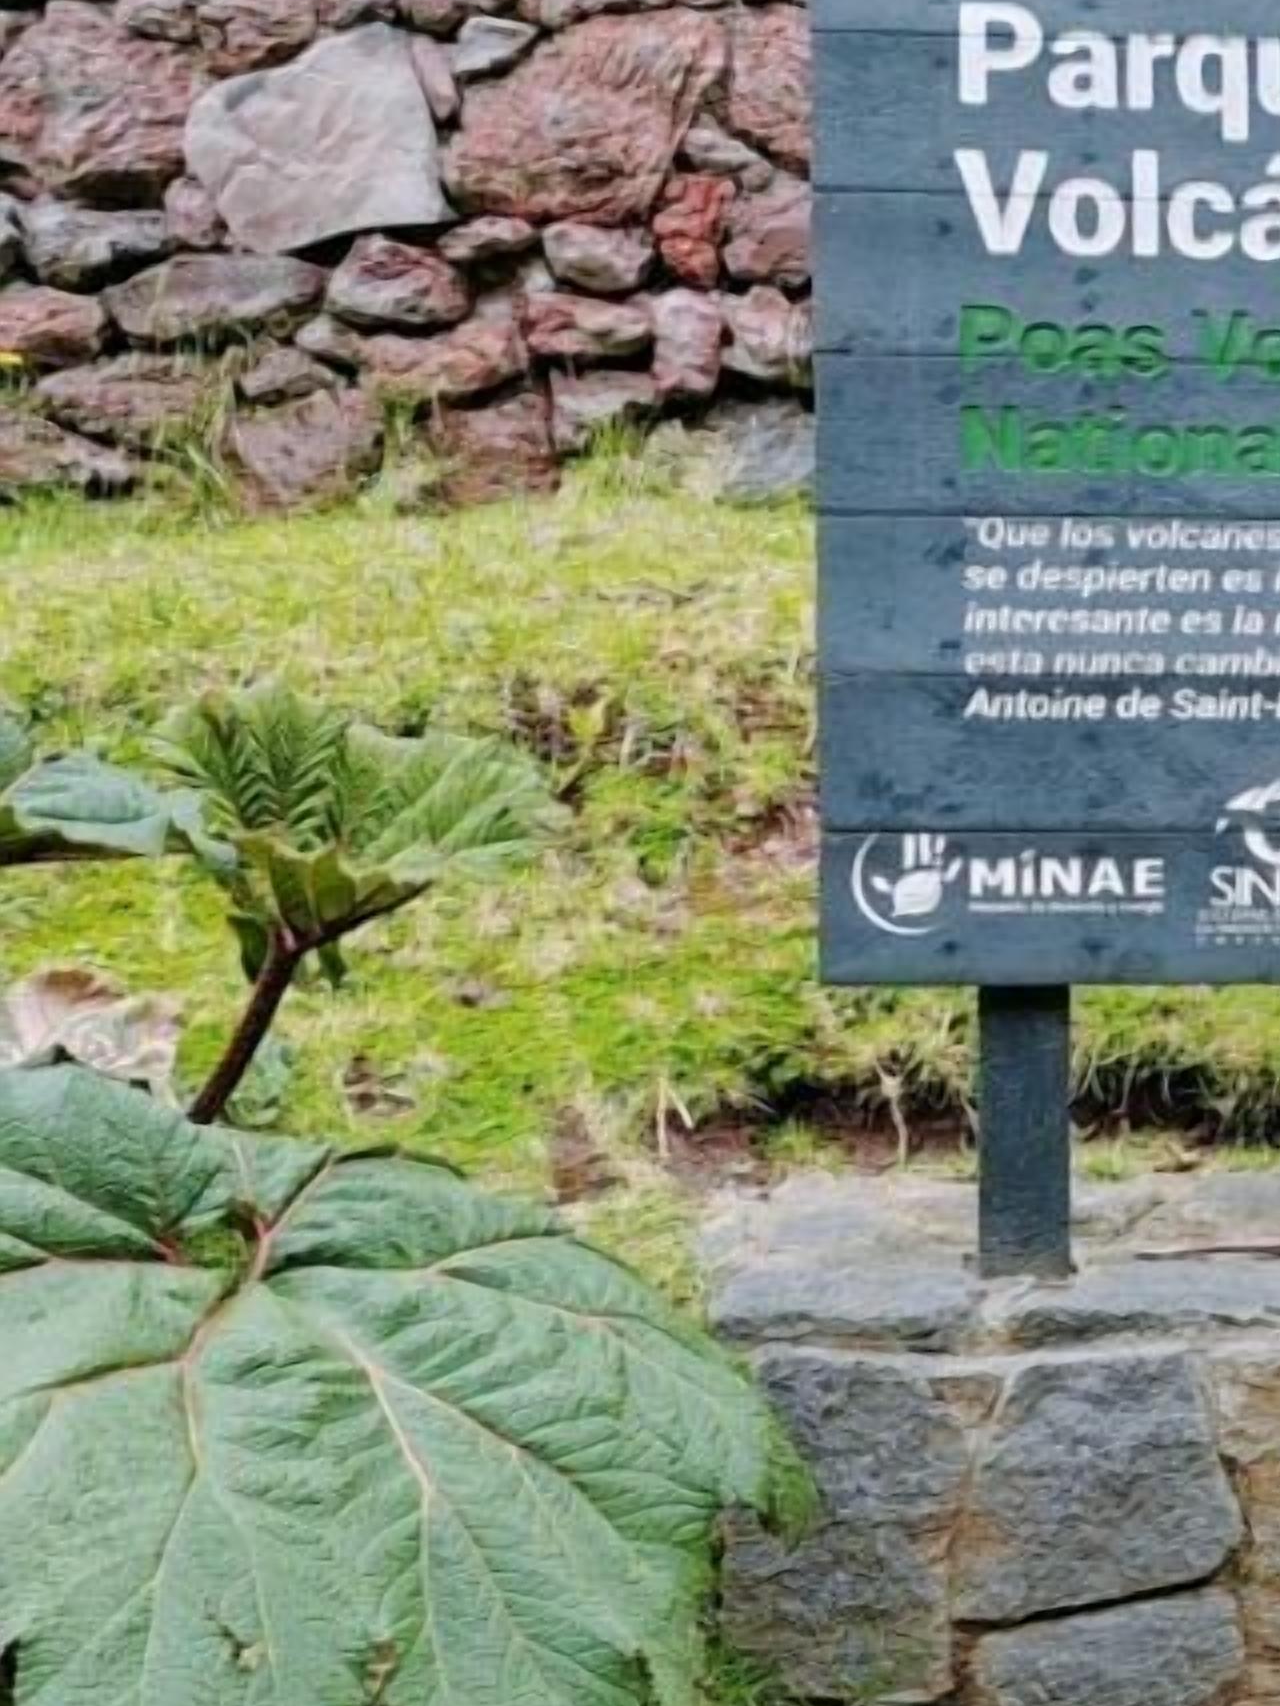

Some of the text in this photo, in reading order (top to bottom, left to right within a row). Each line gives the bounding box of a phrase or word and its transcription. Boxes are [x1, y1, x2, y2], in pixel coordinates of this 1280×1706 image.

[1060, 519, 1114, 549] los
[964, 566, 1005, 590] se
[1017, 561, 1211, 597] despierten
[1222, 570, 1262, 592] es
[964, 602, 1171, 634] interesante
[1180, 610, 1222, 634] es
[1232, 605, 1264, 635] la
[1053, 652, 1165, 677] nunca
[964, 688, 1106, 720] Antoine
[1115, 687, 1162, 719] de
